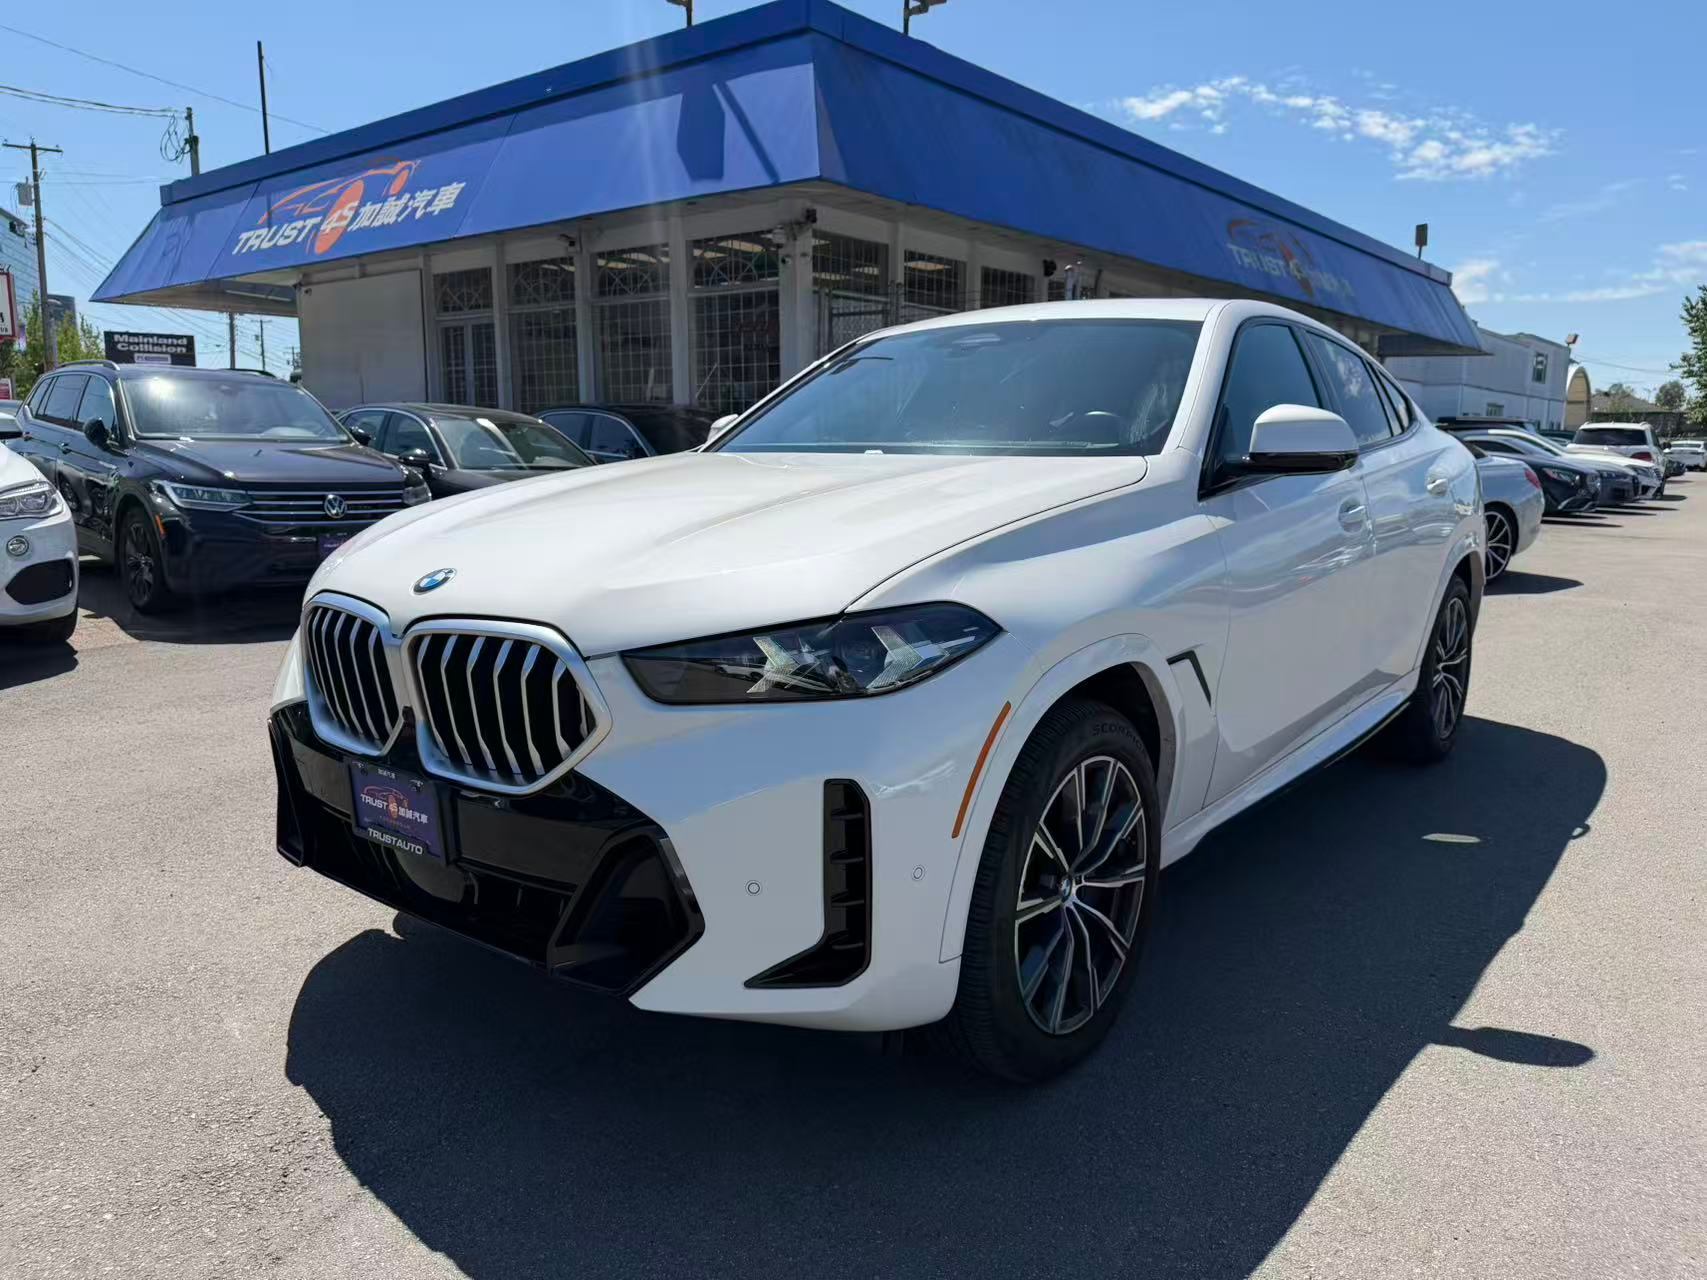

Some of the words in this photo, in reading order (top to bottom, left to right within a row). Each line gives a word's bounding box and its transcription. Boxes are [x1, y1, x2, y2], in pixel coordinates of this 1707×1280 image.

[232, 216, 322, 255] TRUST
[113, 333, 188, 345] Mainland
[116, 342, 187, 353] Collision
[360, 793, 388, 810] TRUST
[368, 827, 423, 855] TRUSTAUTO
